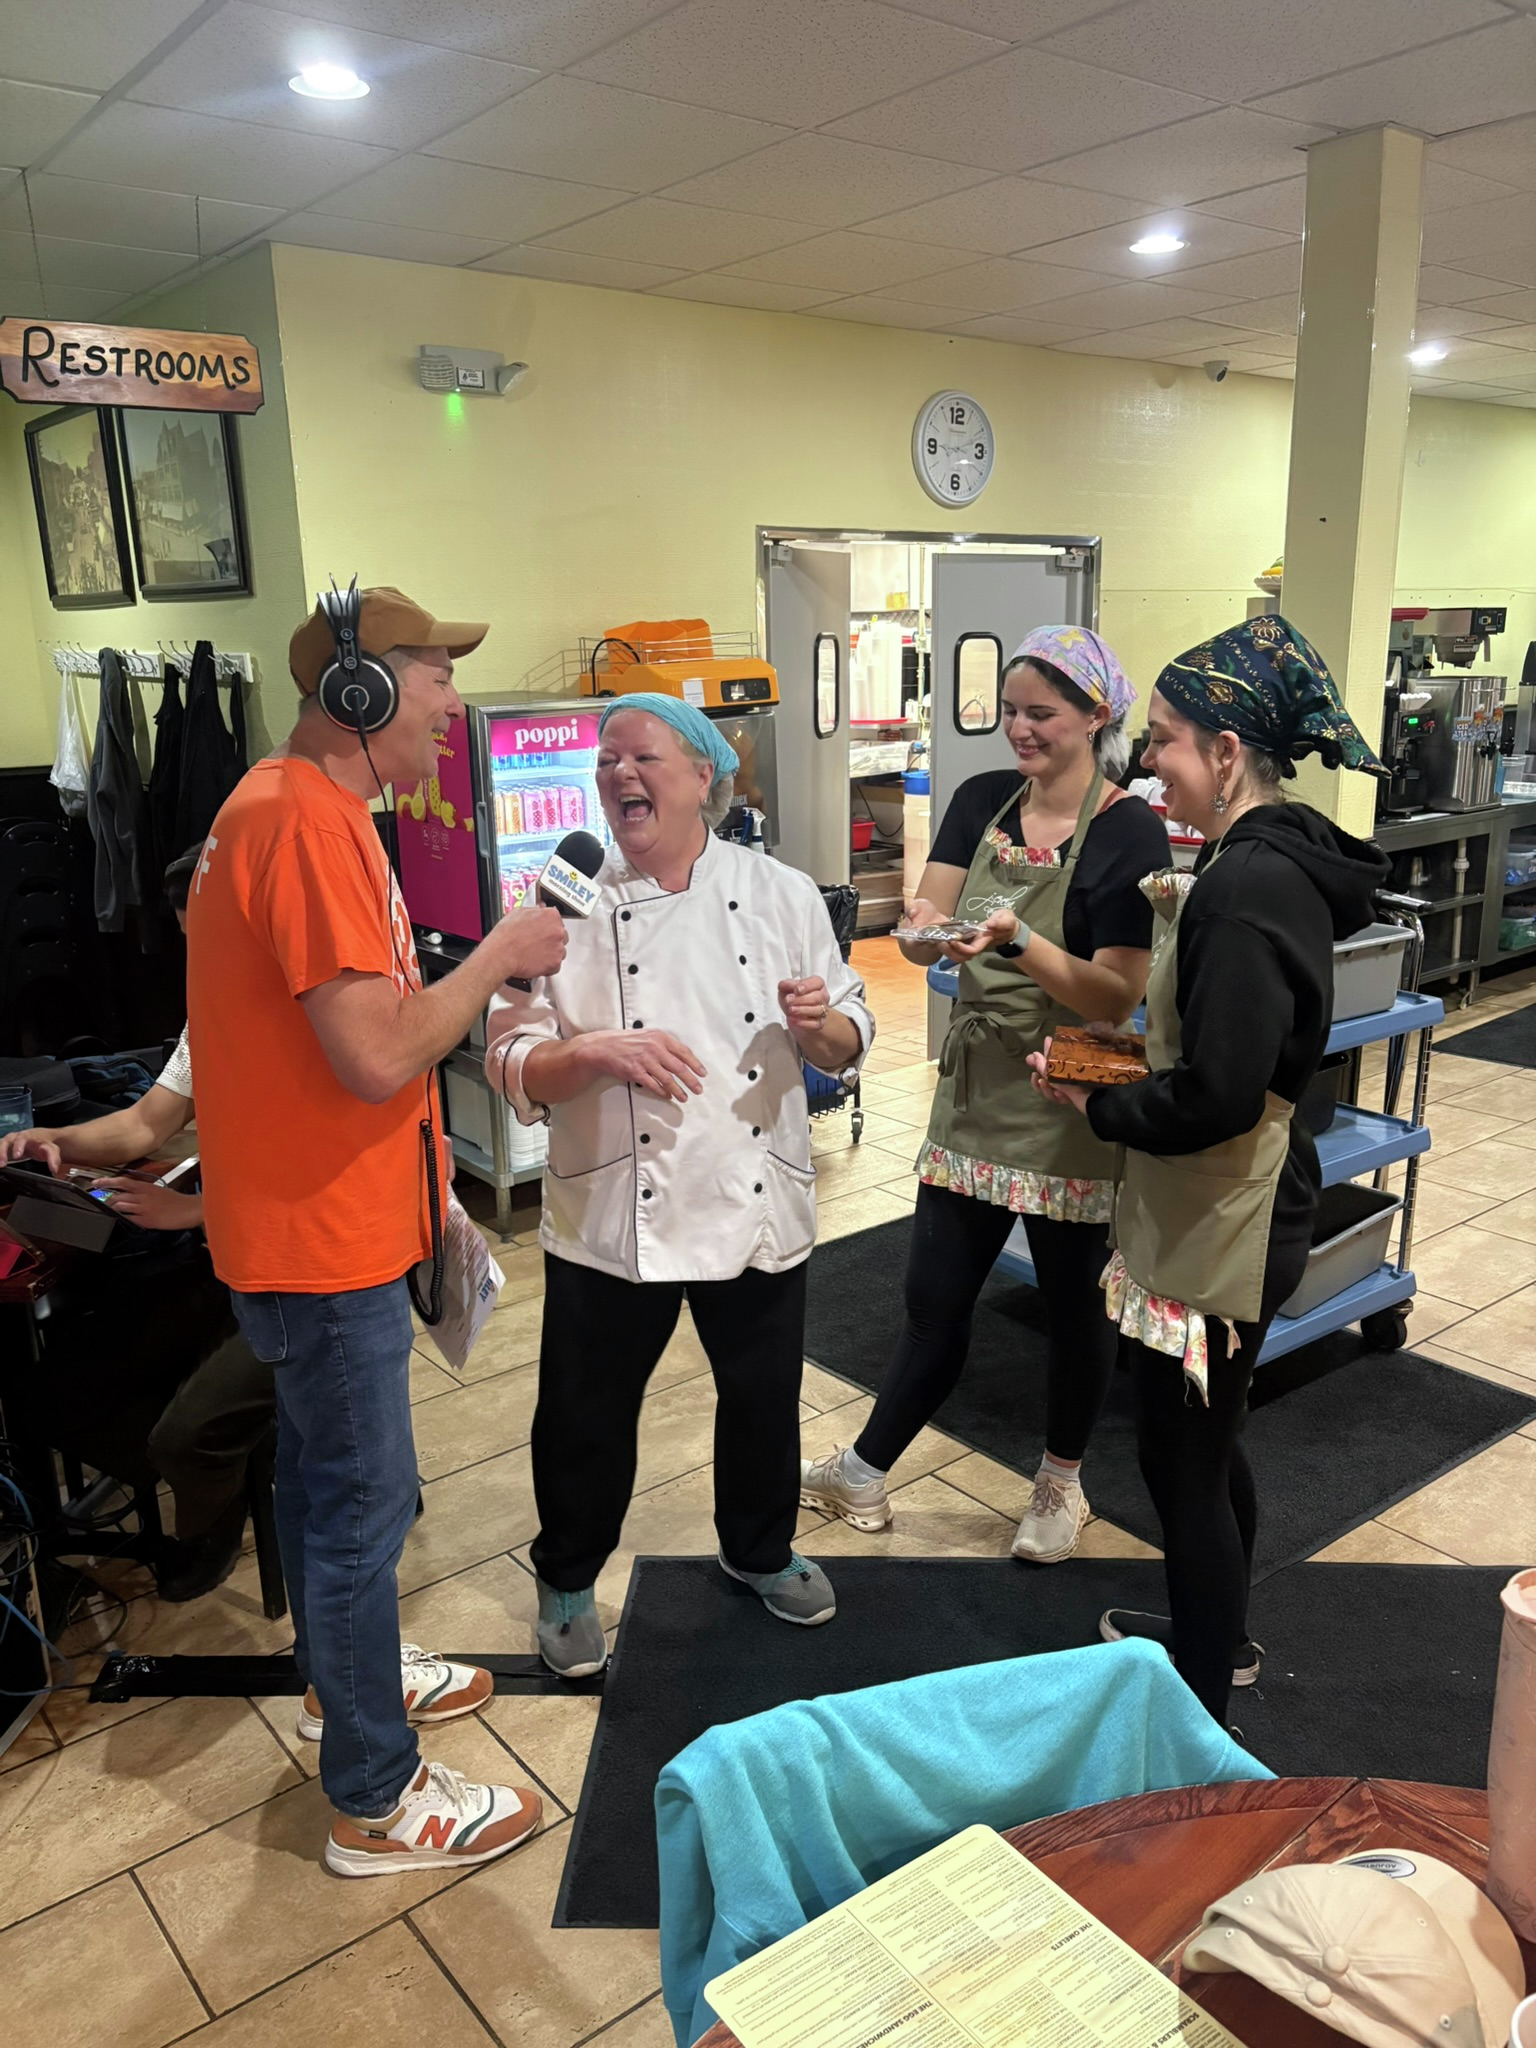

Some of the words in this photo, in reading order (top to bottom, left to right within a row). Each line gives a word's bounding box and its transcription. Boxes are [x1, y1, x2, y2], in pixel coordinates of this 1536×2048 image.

[22, 326, 250, 390] RESTROOMS
[950, 407, 965, 425] 12
[928, 438, 938, 454] 9
[975, 443, 984, 459] 3
[950, 474, 960, 491] 6
[515, 718, 579, 750] poppi
[548, 878, 571, 898] morning
[571, 893, 586, 907] show
[415, 1815, 457, 1849] N
[1079, 1922, 1092, 1932] THE
[1050, 1930, 1080, 1950] OMELETS
[903, 2009, 919, 2021] EGG
[918, 2001, 932, 2011] THE
[1157, 2012, 1199, 2043] SCRAMBLERS
